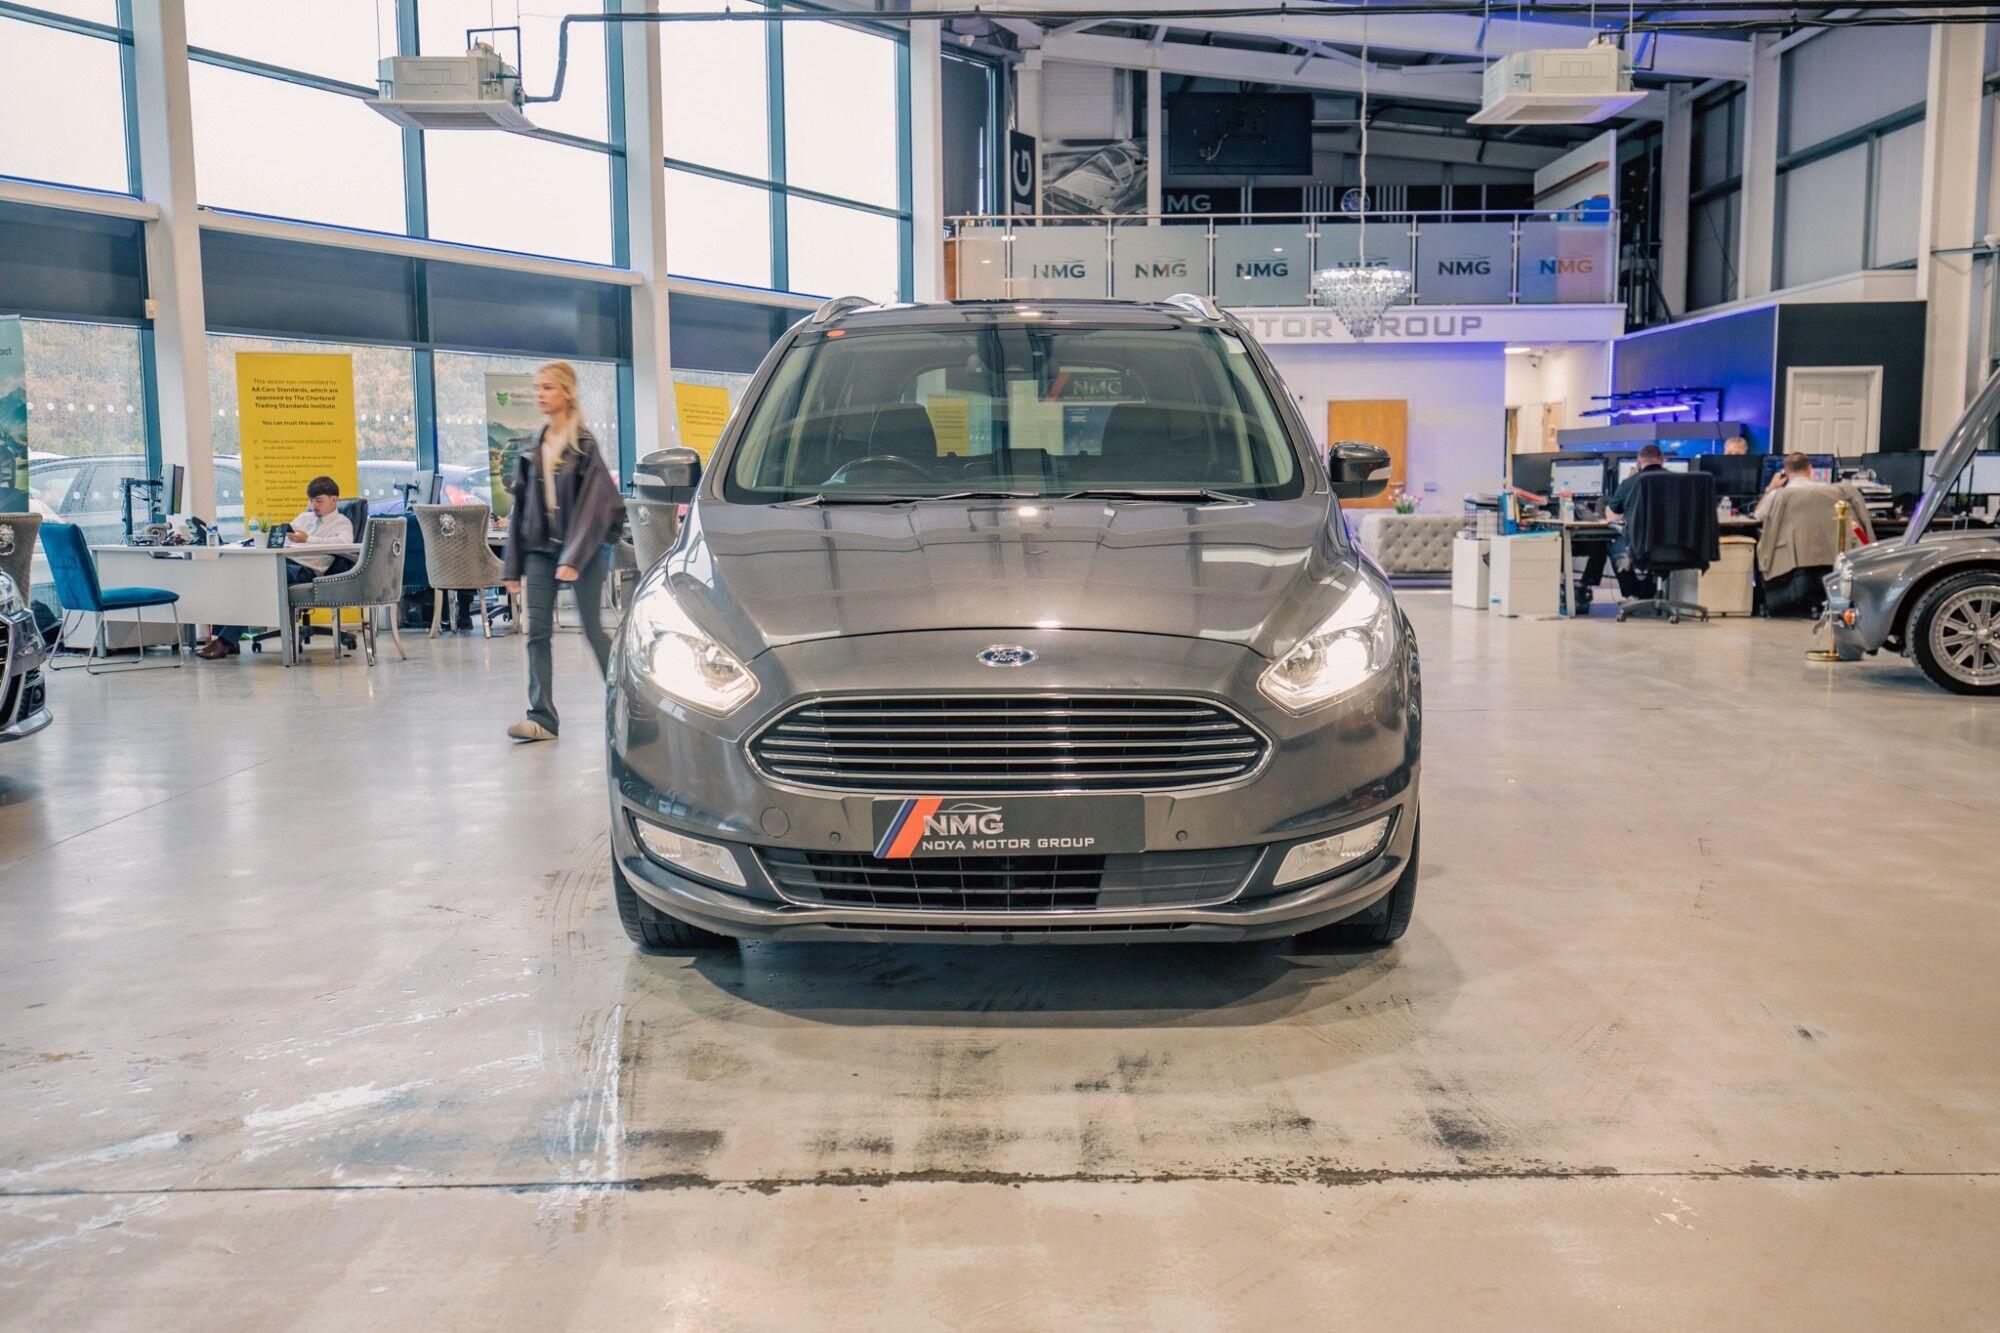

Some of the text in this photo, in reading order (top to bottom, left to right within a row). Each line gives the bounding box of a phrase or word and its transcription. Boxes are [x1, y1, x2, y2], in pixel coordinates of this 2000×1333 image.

[1161, 194, 1212, 212] MG
[1033, 263, 1086, 279] NMG
[1134, 263, 1188, 278] NMG
[1235, 262, 1289, 278] NMG
[1438, 260, 1491, 276] NMG
[1539, 259, 1593, 275] NMG
[1352, 315, 1482, 337] ROUP
[923, 813, 1005, 836] NMG
[922, 837, 1095, 851] NOYA MOTOR GROUP
